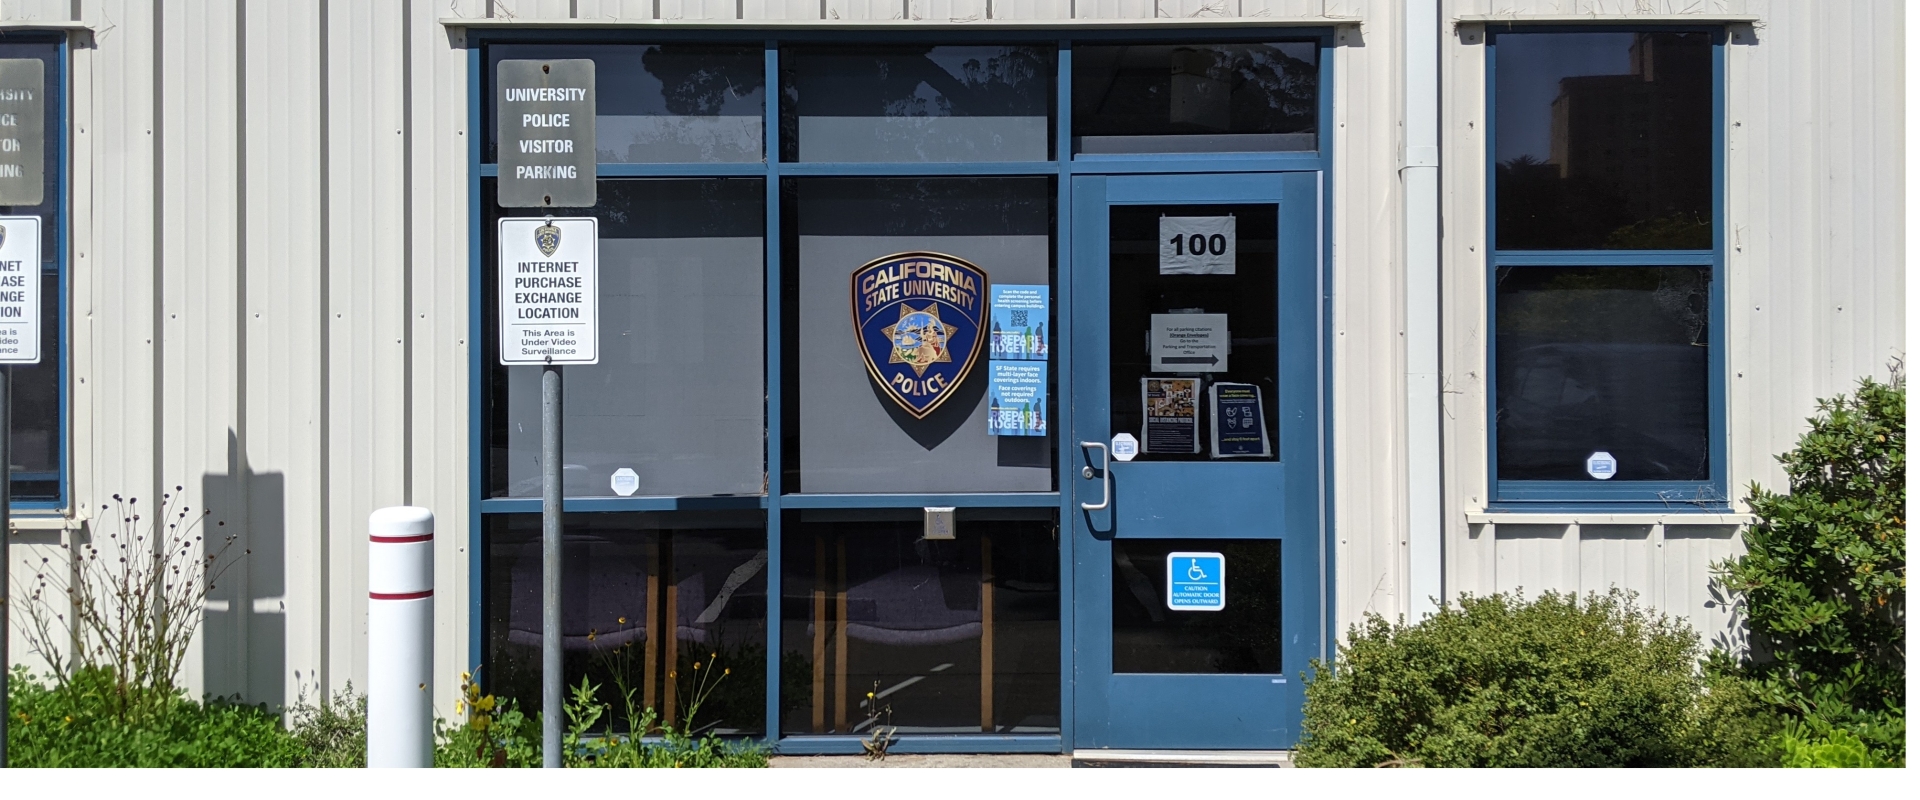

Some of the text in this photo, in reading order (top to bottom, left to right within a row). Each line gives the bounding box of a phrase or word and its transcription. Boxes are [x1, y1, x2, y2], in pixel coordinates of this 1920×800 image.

[505, 88, 586, 102] UNIVERSITY
[522, 113, 570, 128] POLICE
[519, 139, 574, 153] VISITOR
[516, 165, 577, 179] PARKING
[1170, 233, 1227, 256] 100
[517, 261, 579, 273] INTERNET
[515, 276, 582, 289] PURCHASE
[862, 262, 977, 296] CALIFORNIA
[515, 292, 582, 304] EXCHANGE
[865, 280, 975, 312] STATE UNIVERSITY
[518, 307, 579, 319] LOCATION
[9, 327, 17, 336] is
[522, 329, 575, 337] This Area is
[521, 338, 577, 346] Under Video
[993, 335, 1042, 346] PREPARE
[521, 347, 577, 355] Surveillance
[990, 341, 1048, 353] TOGETHER
[891, 372, 948, 396] POLICE
[992, 411, 1039, 421] PREPARE
[988, 417, 1046, 429] TOGETHER
